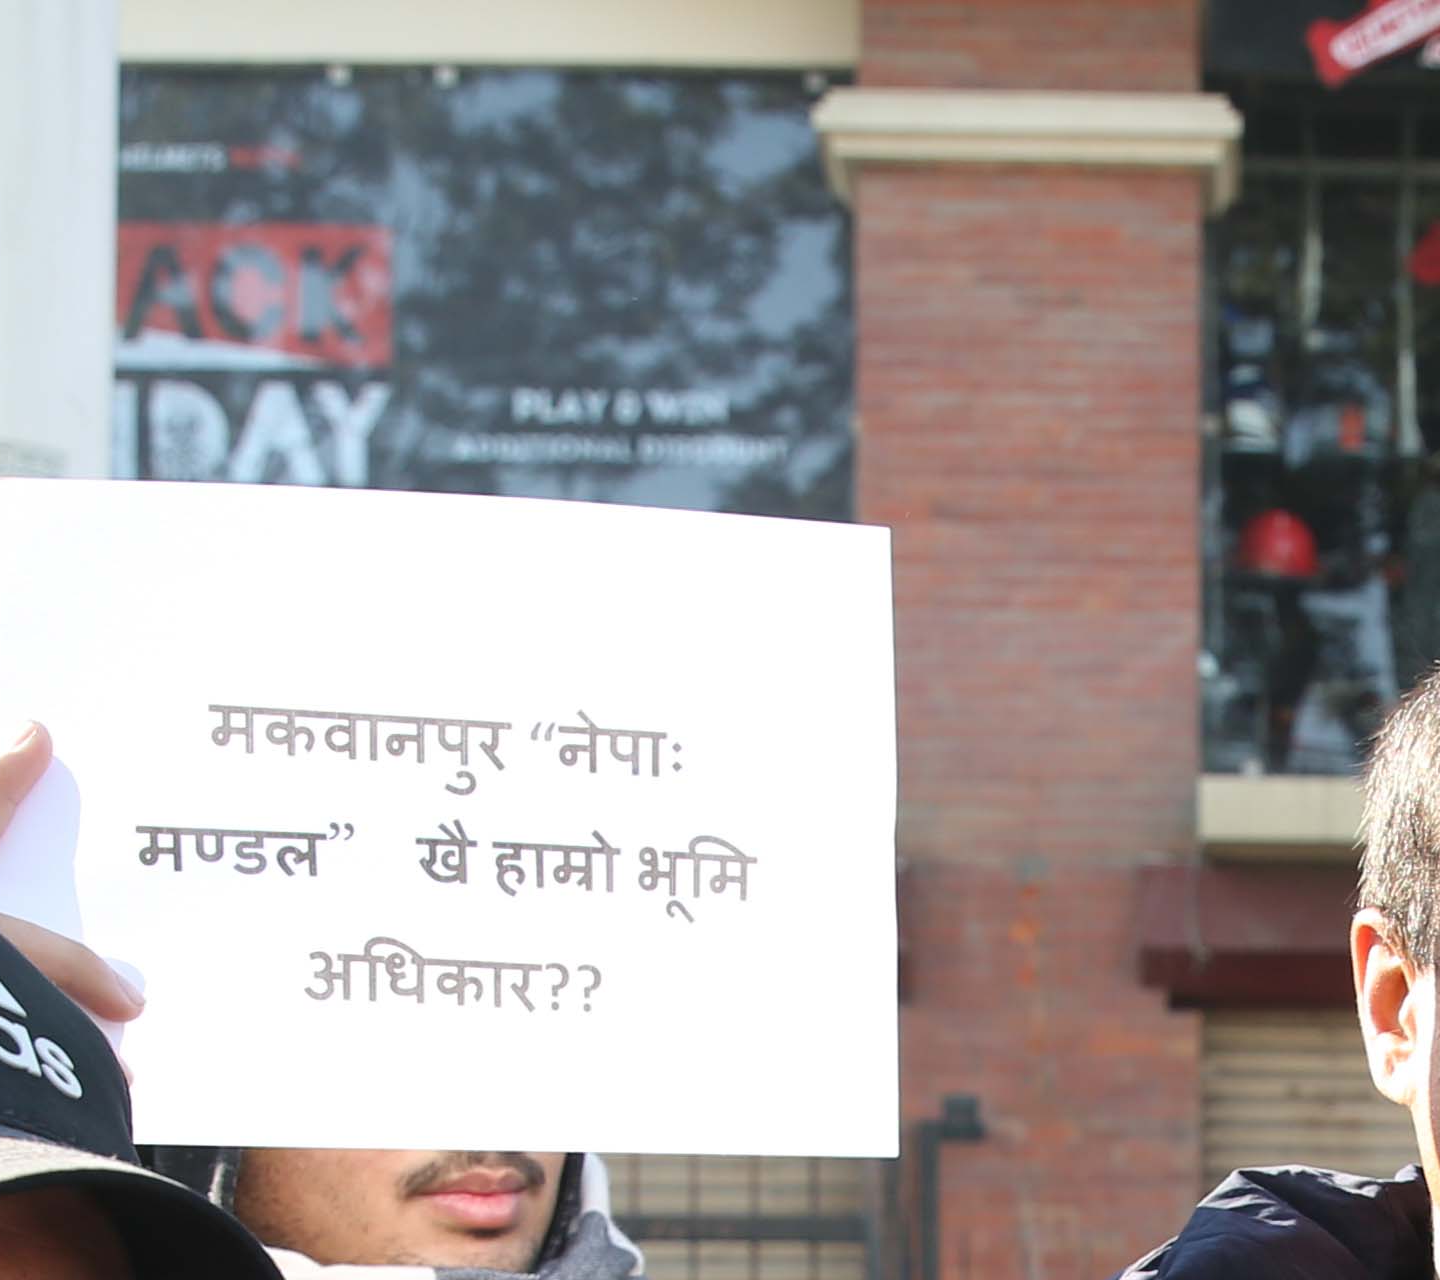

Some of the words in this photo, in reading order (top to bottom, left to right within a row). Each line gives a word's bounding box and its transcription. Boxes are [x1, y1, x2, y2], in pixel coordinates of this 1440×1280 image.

[122, 243, 368, 343] ACK
[208, 704, 513, 796] मकवानपुर
[415, 819, 478, 885] खै
[491, 829, 621, 897] हाम्रो
[638, 835, 758, 923] भूमि
[304, 936, 602, 1013] अधिकार??
